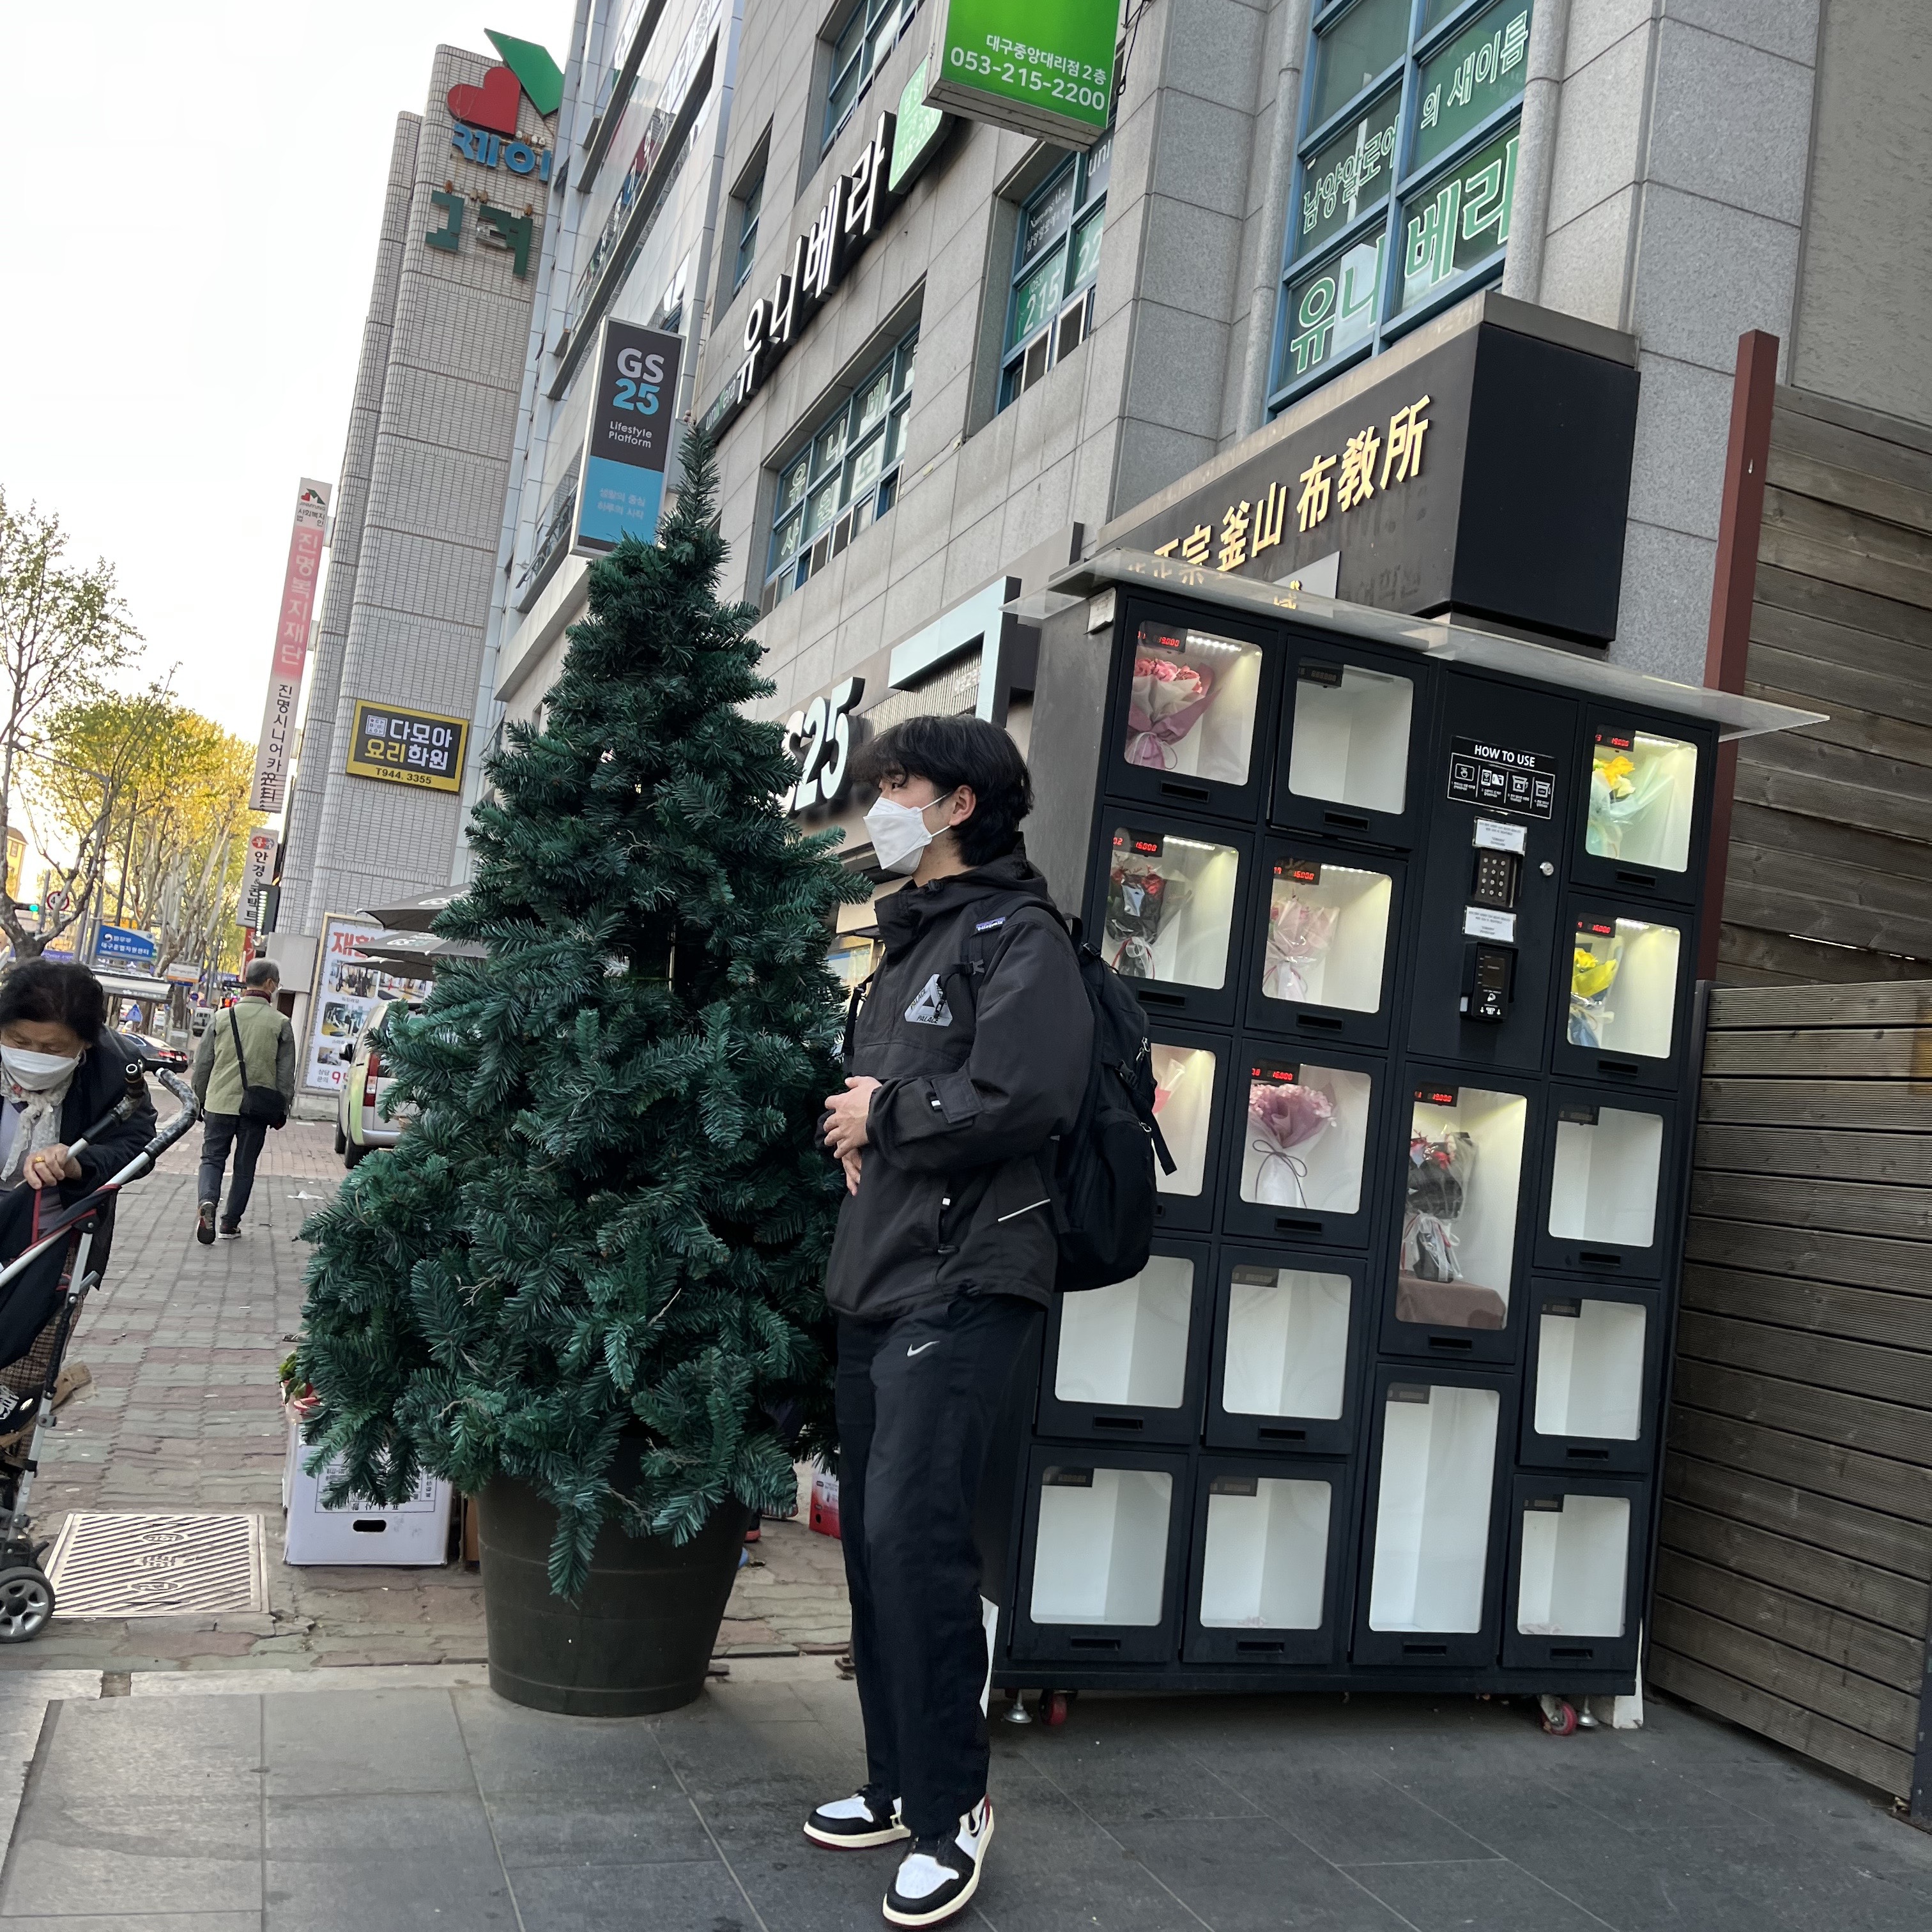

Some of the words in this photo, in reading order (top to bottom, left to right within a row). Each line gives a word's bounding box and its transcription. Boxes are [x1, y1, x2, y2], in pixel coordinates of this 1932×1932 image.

[986, 34, 1080, 77] 대구중앙대리점
[1082, 65, 1107, 86] 2층
[950, 47, 1105, 111] 053-215-2200
[737, 111, 885, 404] 유니베라
[617, 347, 664, 383] GS
[612, 378, 659, 415] 25
[608, 431, 652, 448] Platform
[610, 420, 652, 439] Lifestyle
[280, 532, 319, 666] 진명복지재단
[390, 719, 453, 748] 다모아
[364, 738, 448, 770] 요리학원
[1474, 744, 1500, 760] HOW
[1501, 750, 1515, 763] TO
[1517, 755, 1535, 767] USE
